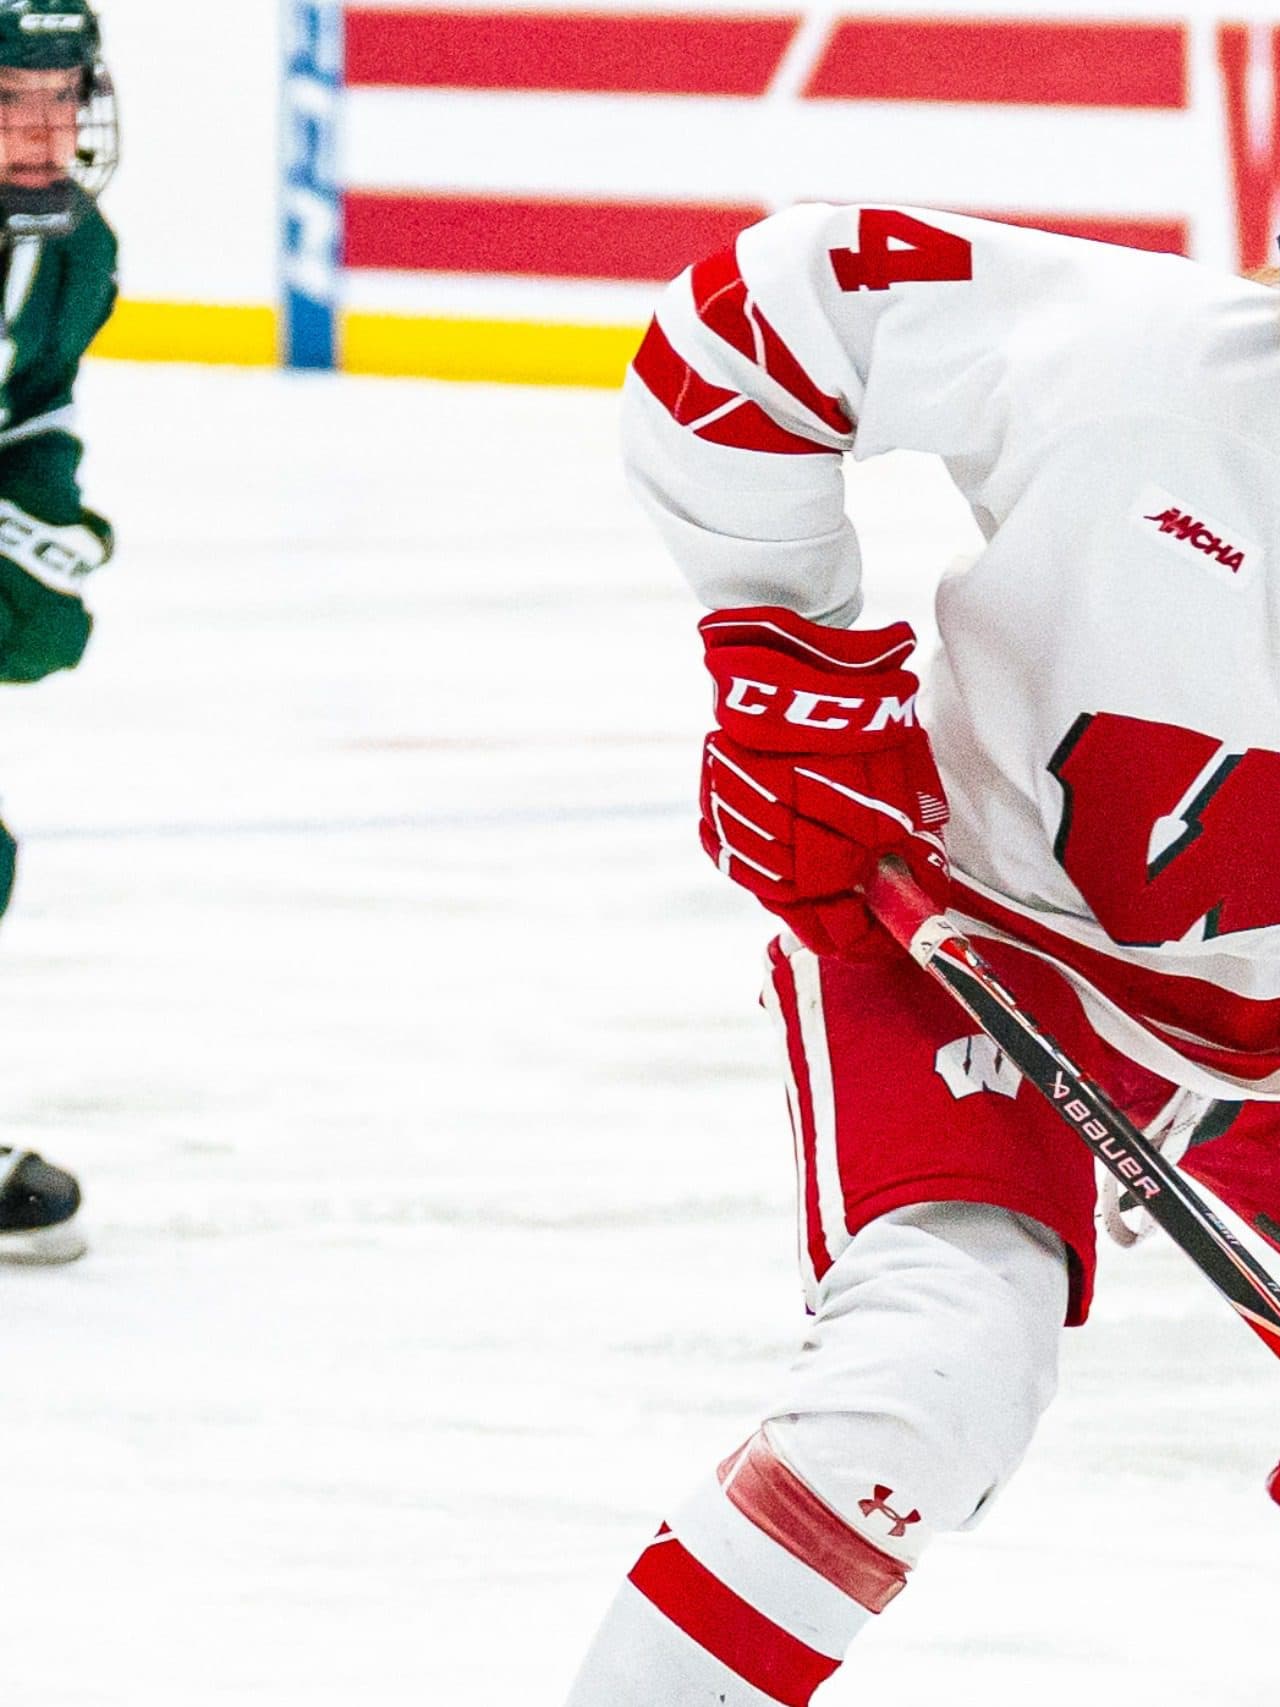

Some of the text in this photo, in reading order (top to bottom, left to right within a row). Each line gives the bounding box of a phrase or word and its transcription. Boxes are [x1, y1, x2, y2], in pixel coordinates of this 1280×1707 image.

[828, 208, 973, 293] 4
[725, 675, 917, 732] CCM
[1063, 1099, 1160, 1199] BAUER
